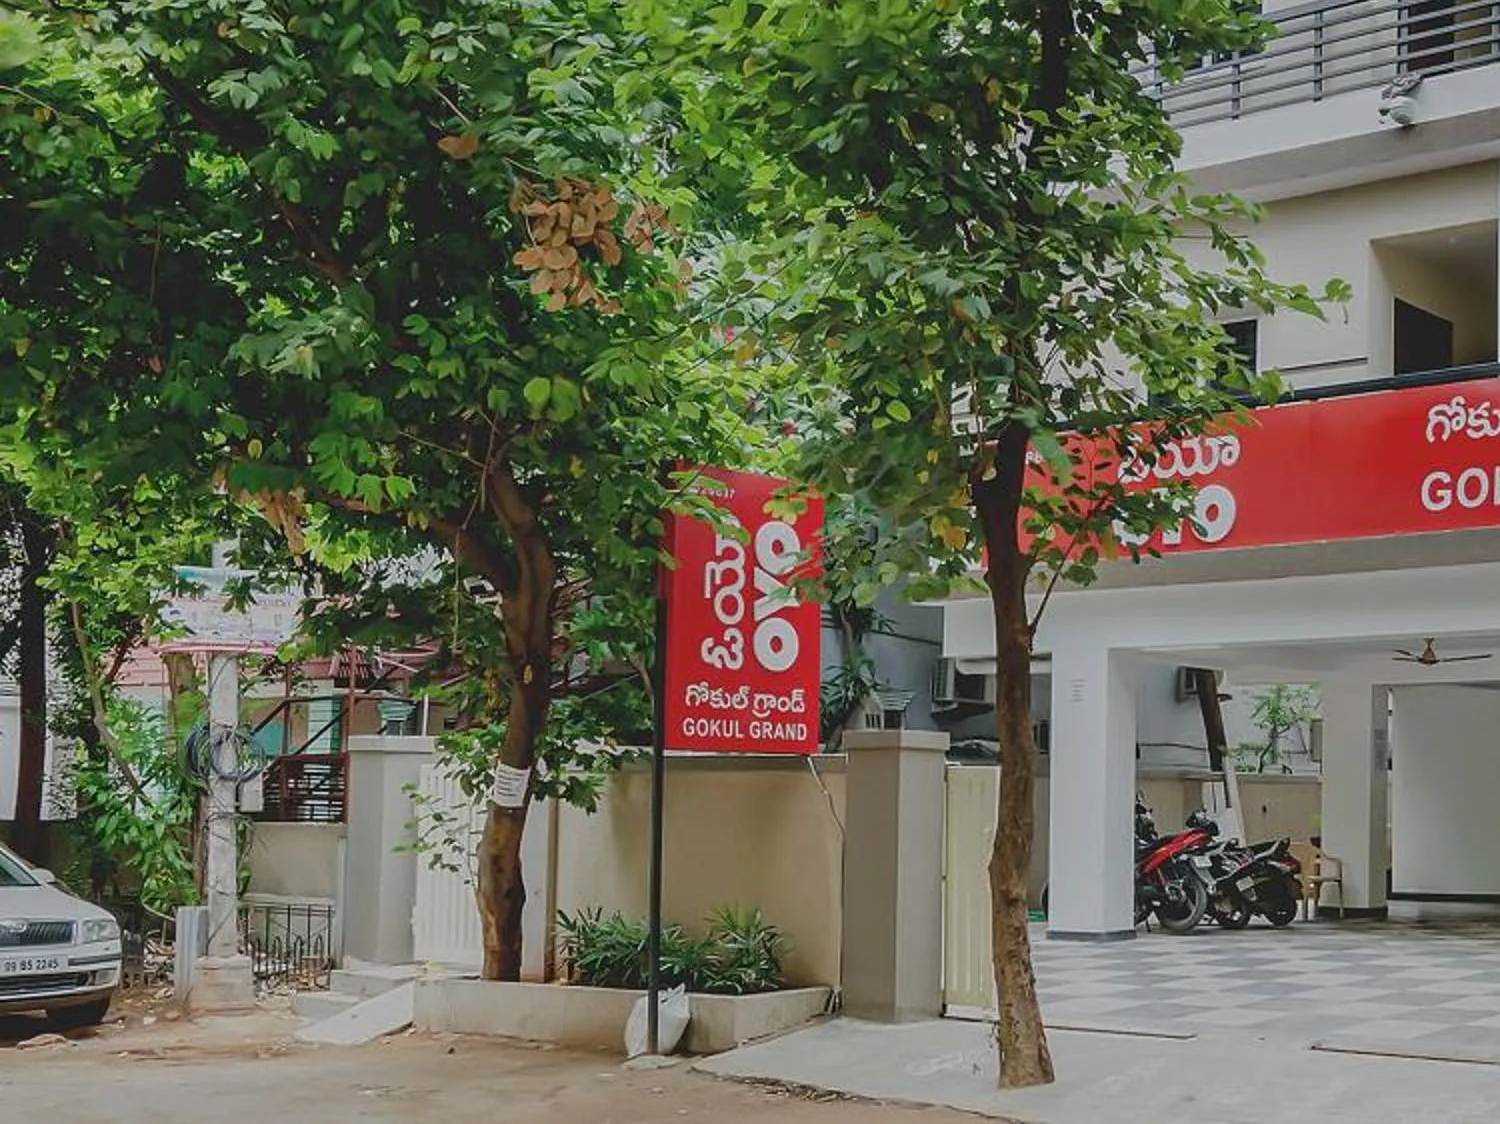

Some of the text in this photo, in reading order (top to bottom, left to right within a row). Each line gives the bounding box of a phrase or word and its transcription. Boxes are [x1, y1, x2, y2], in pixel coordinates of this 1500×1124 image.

[753, 520, 801, 673] OYO
[683, 717, 808, 742] GOKUL GRAND
